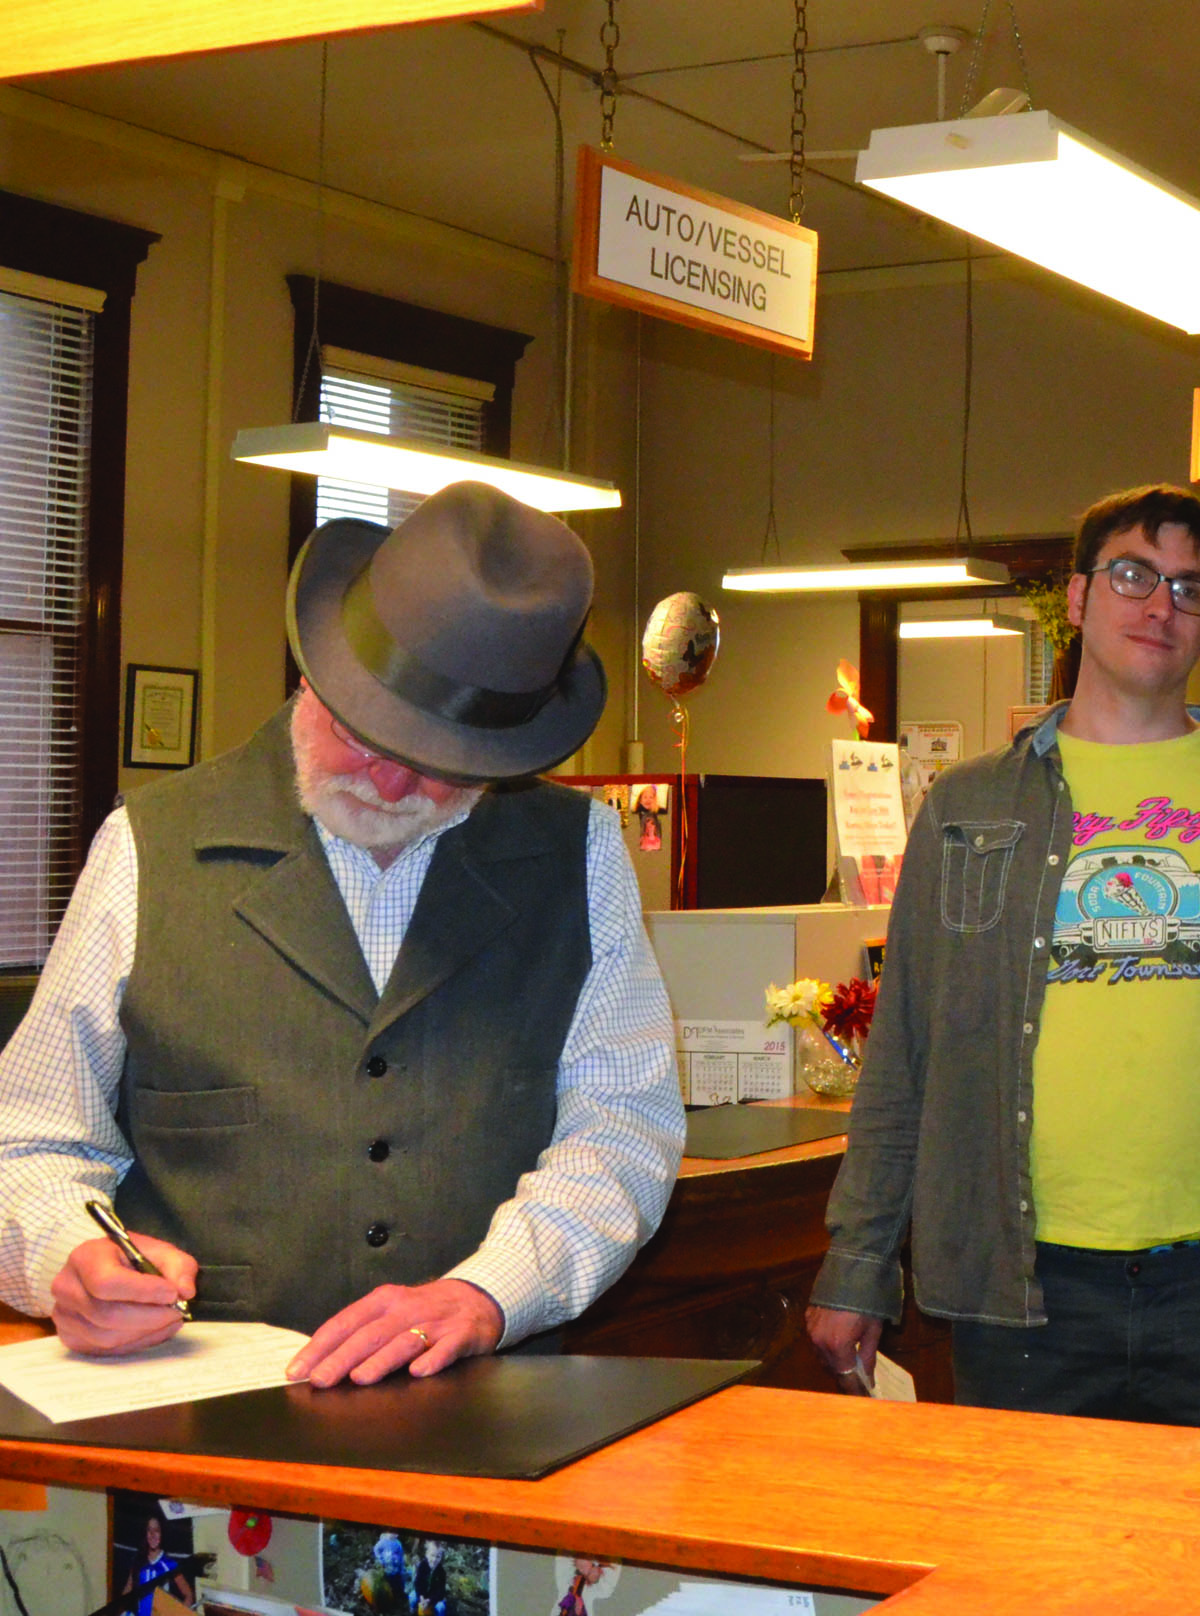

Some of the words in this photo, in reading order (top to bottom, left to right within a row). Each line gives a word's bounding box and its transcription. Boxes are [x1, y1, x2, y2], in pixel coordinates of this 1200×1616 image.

[625, 194, 792, 279] AUTO/VESSEL
[650, 247, 767, 313] LICENSING
[1101, 919, 1159, 940] NIFTYS
